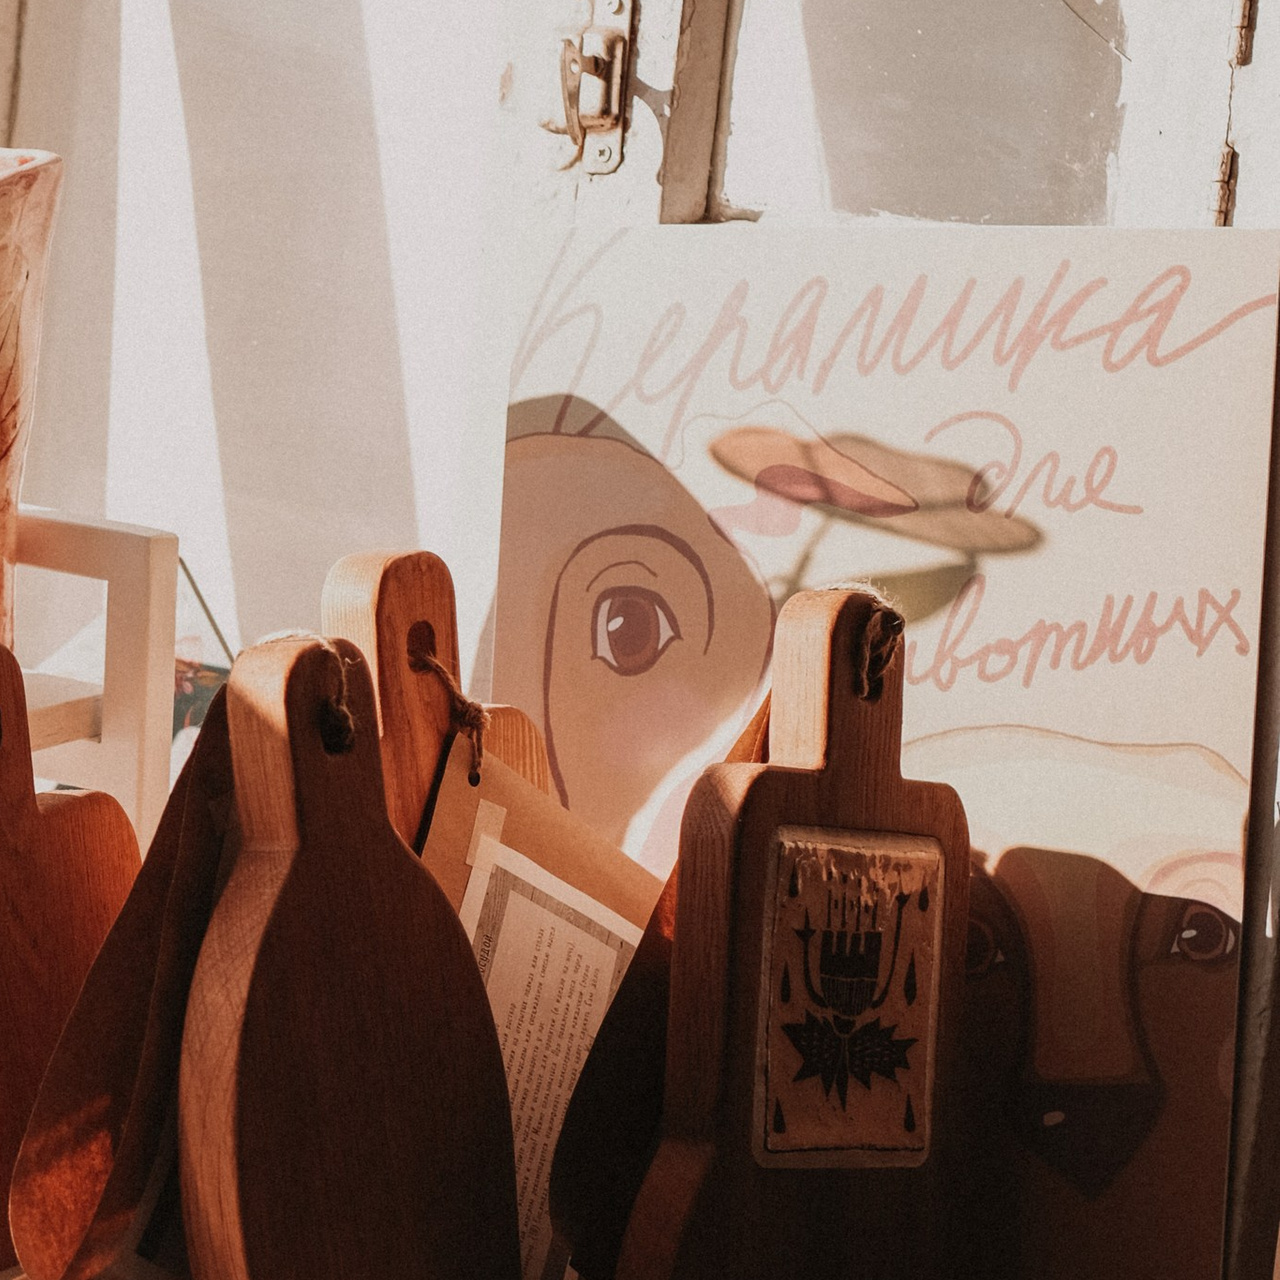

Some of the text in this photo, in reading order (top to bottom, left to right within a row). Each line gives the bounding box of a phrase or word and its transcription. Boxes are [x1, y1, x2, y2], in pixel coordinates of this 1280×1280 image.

[509, 227, 1279, 465] Керамика
[904, 573, 1251, 692] вотных
[476, 934, 493, 974] осудой
